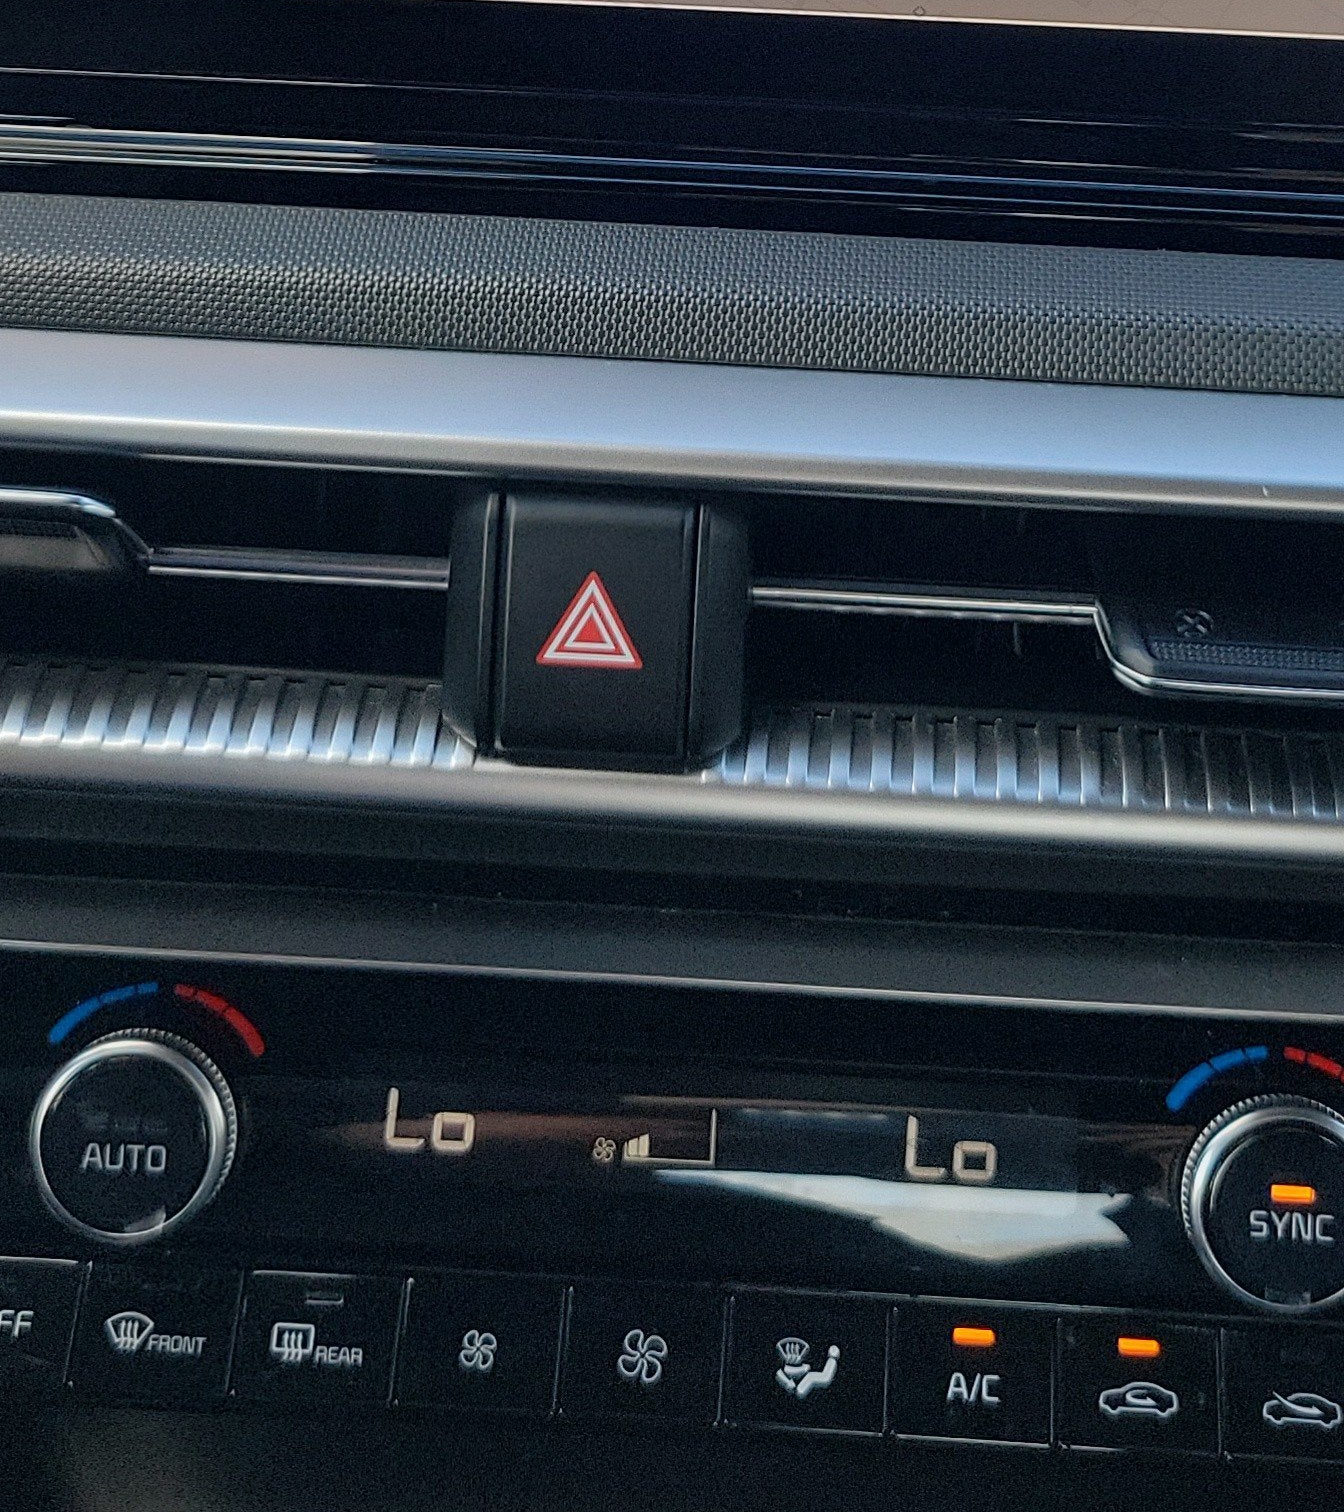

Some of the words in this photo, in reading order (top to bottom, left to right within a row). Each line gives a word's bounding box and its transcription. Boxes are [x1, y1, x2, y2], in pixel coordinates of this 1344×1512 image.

[384, 1086, 477, 1154] Lo
[80, 1142, 167, 1173] AUTO
[905, 1114, 997, 1181] Lo
[1248, 1210, 1335, 1244] SYNC
[145, 1334, 207, 1356] FRONT
[315, 1345, 363, 1367] REAR
[946, 1372, 1001, 1405] A/C
